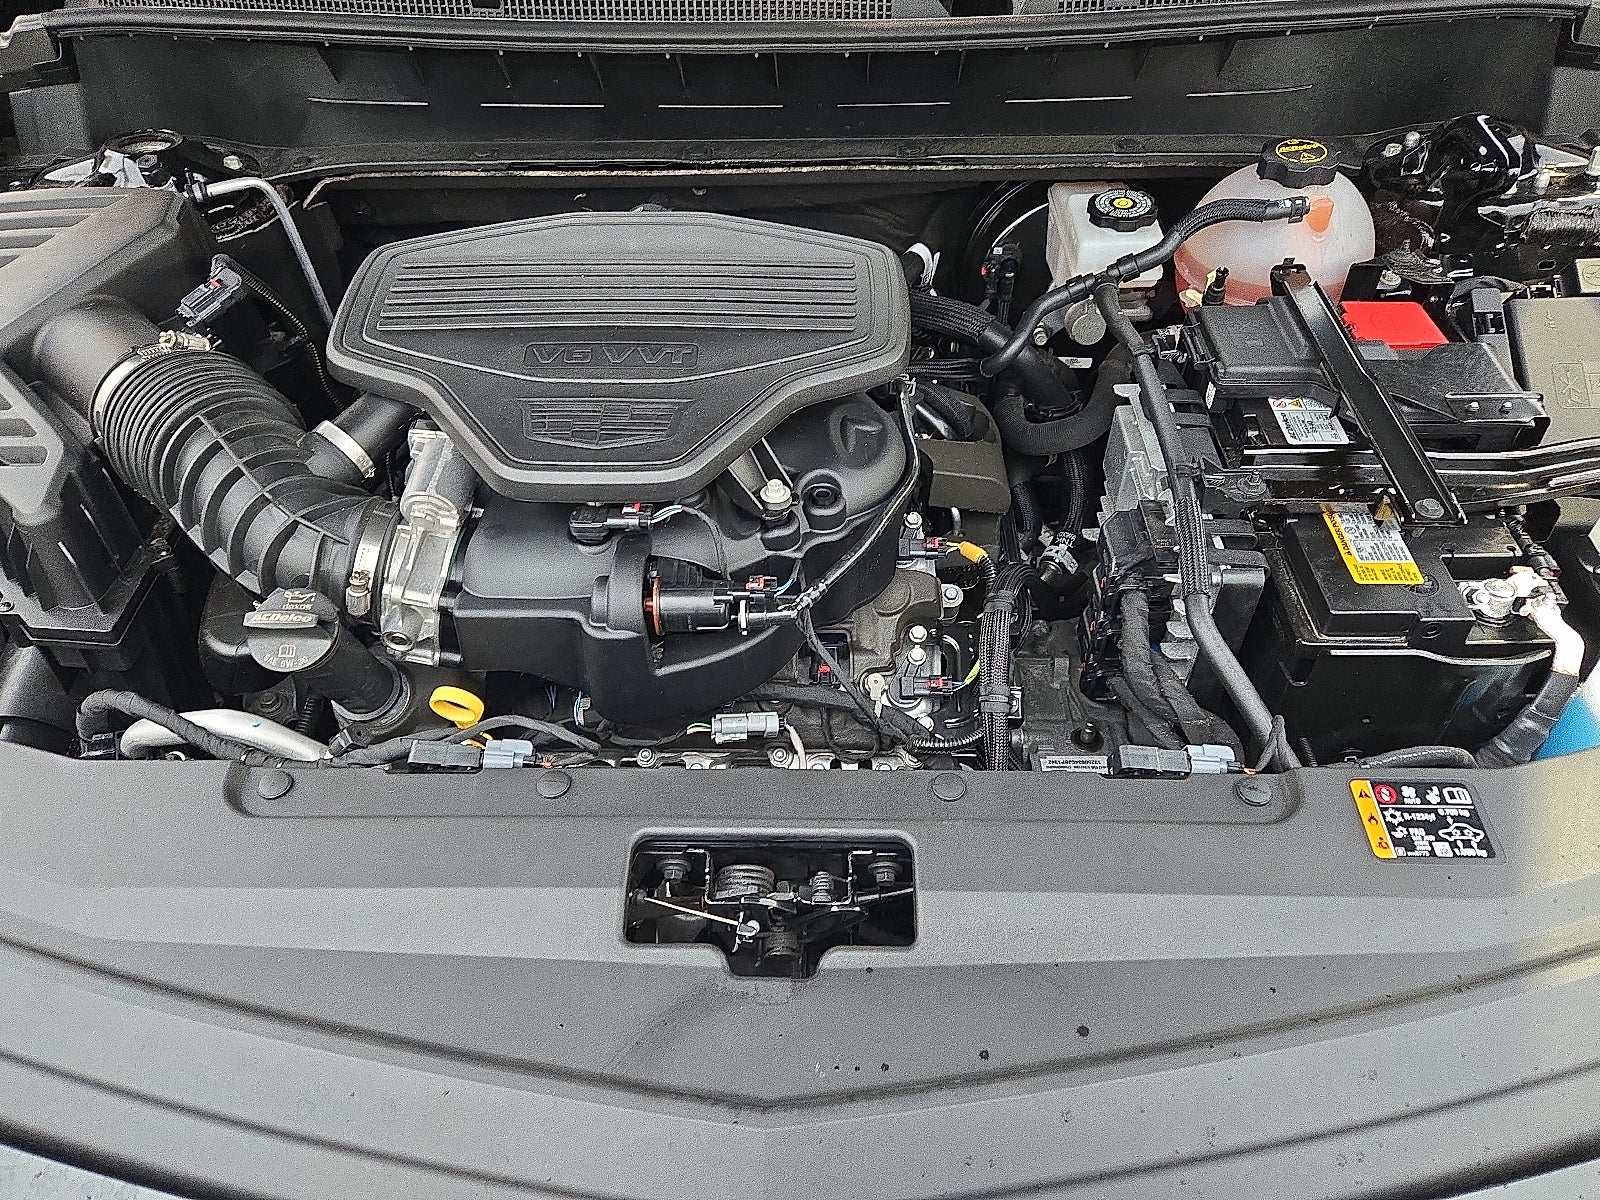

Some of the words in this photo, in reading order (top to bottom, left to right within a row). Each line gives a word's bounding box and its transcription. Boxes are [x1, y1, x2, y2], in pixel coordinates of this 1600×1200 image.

[532, 347, 592, 364] V6
[602, 345, 693, 364] VVT
[253, 613, 313, 622] ACDelco
